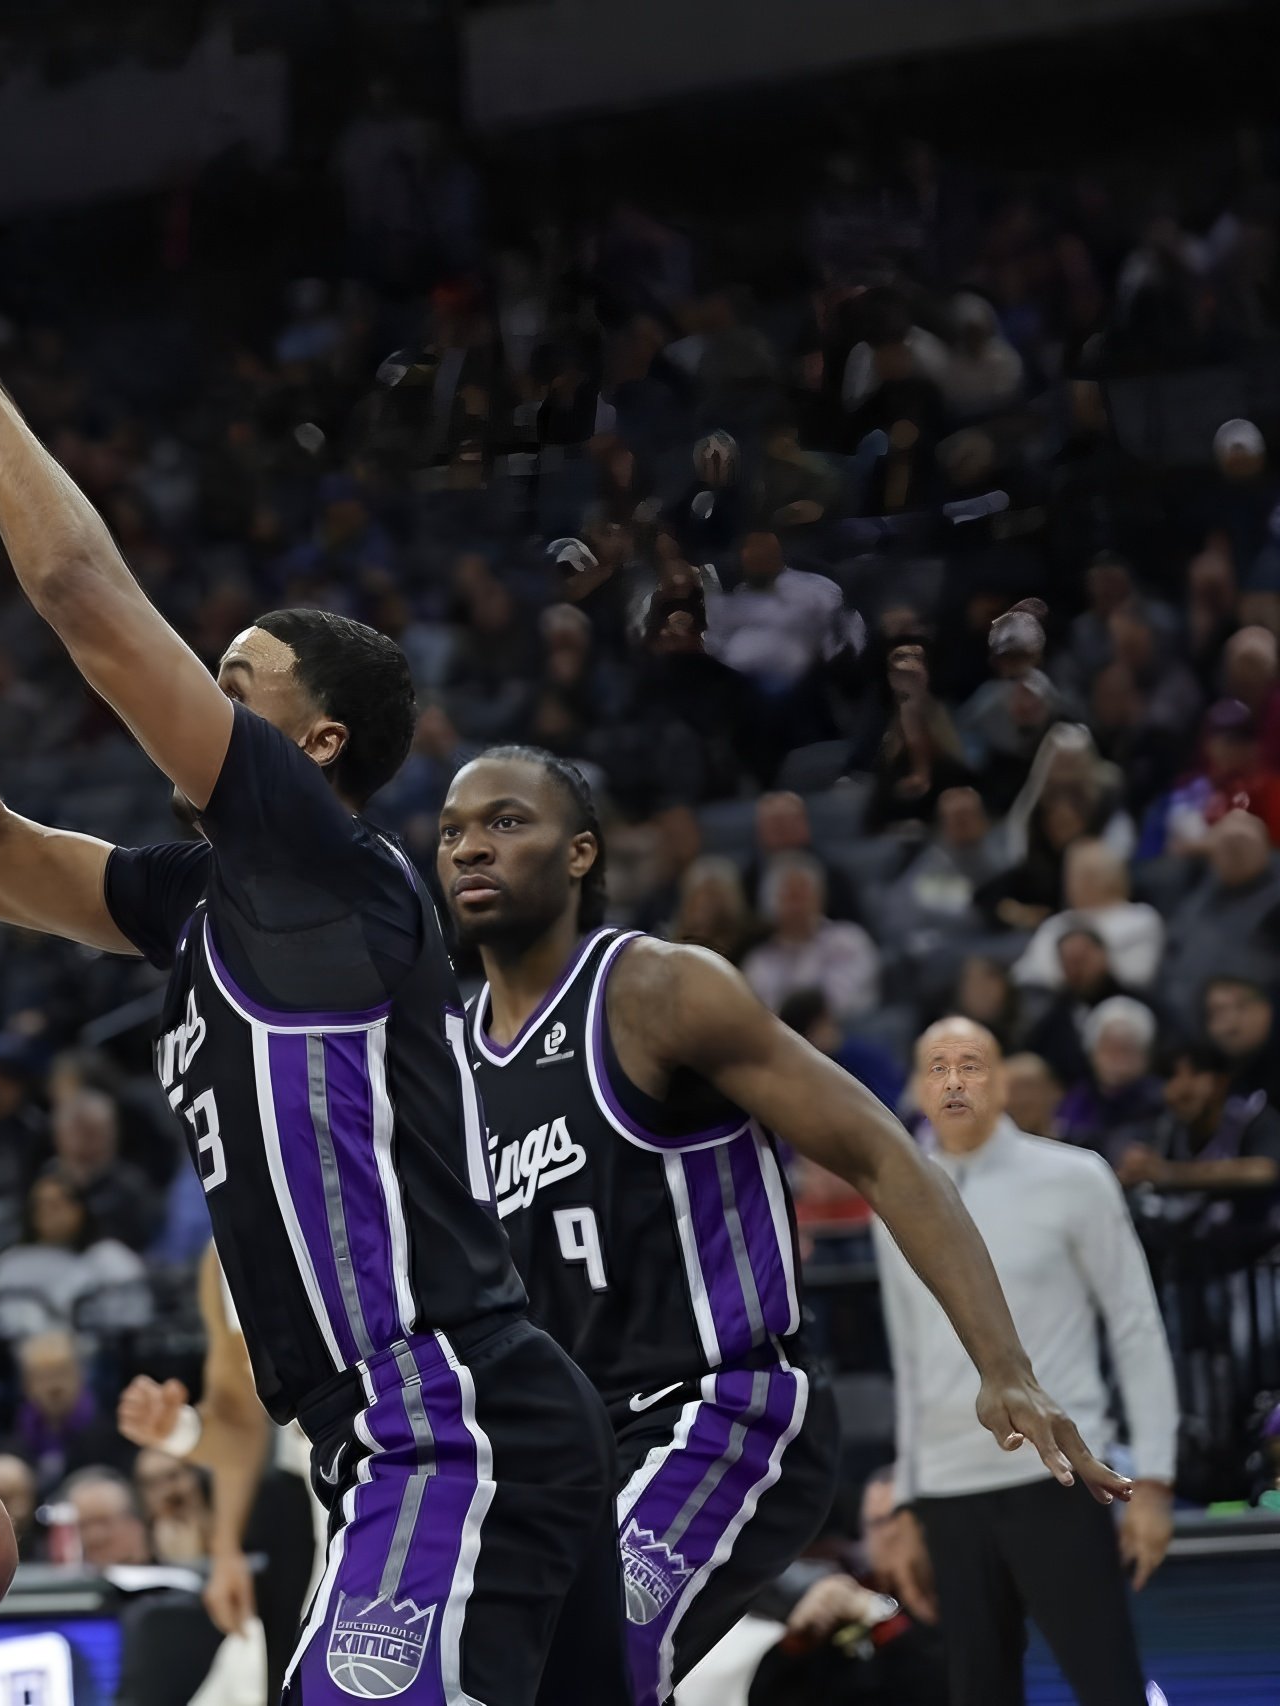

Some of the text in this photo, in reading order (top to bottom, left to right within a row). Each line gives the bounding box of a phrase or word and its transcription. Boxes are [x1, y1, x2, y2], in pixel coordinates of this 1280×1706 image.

[486, 1115, 587, 1220] ings
[552, 1206, 608, 1291] 9
[329, 1632, 422, 1669] KINGS
